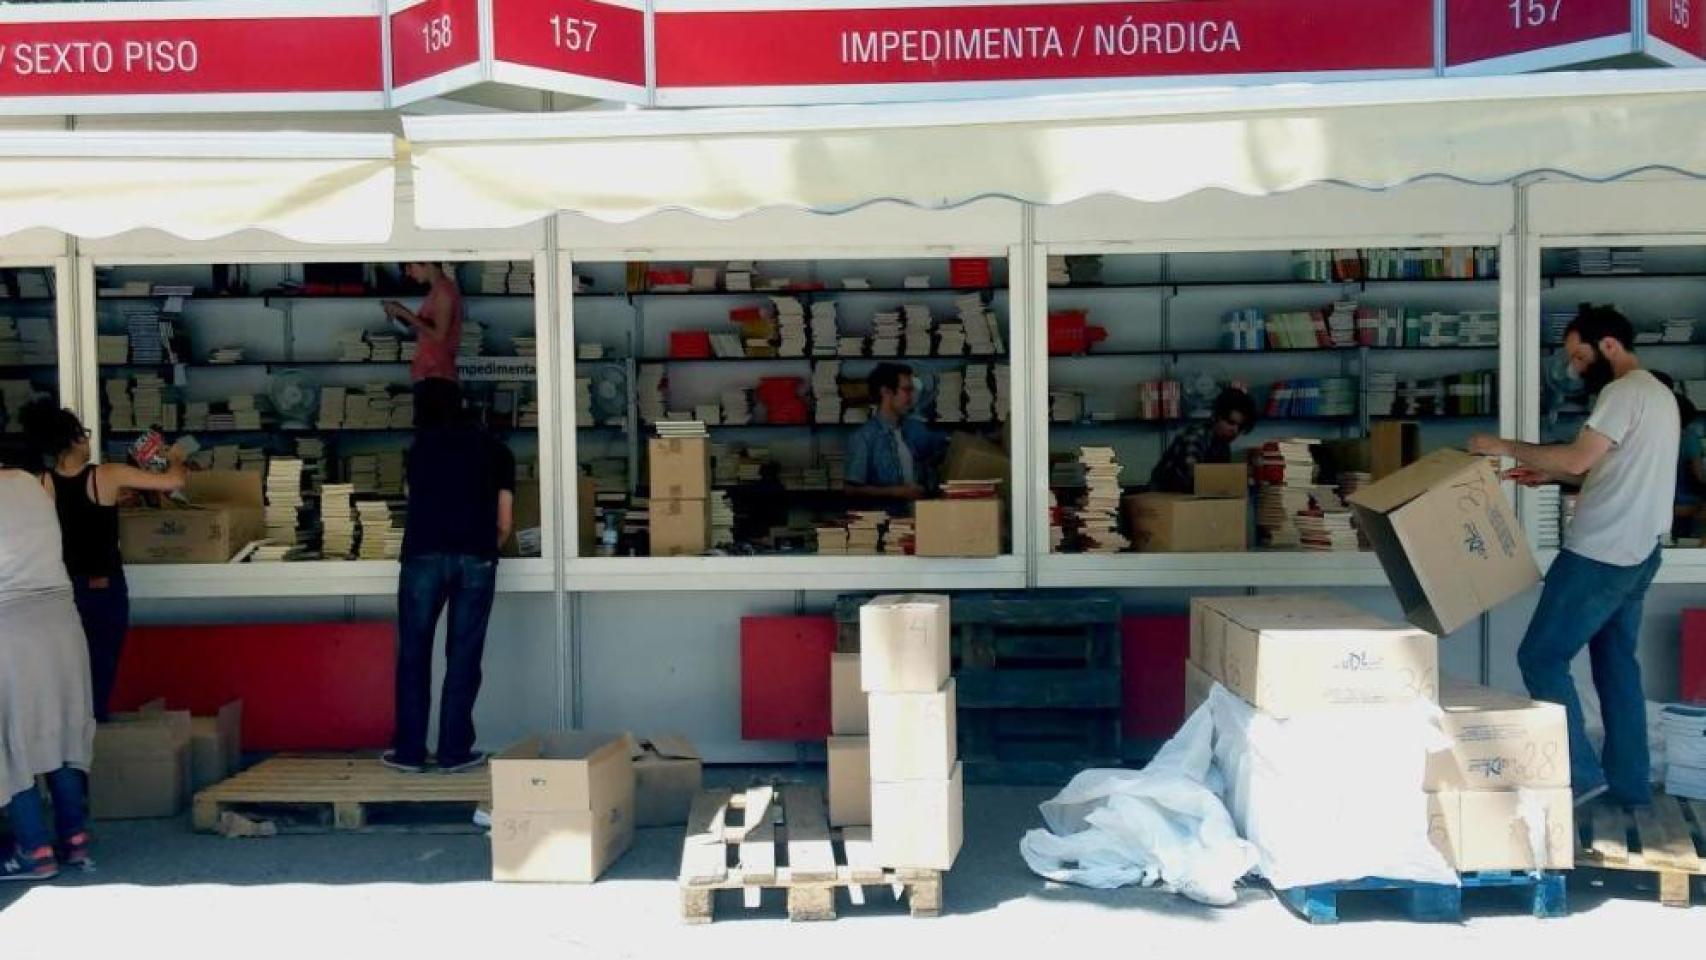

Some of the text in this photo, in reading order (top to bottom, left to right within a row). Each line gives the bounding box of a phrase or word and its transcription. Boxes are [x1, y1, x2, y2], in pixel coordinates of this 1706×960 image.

[1509, 0, 1561, 29] 157
[421, 13, 453, 54] 158
[549, 14, 598, 53] 157
[841, 16, 1241, 63] IMPEDIMENTA / NÓRDICA
[13, 41, 113, 75] SEXTO
[125, 40, 198, 73] PISO
[456, 361, 536, 376] mpedimenta
